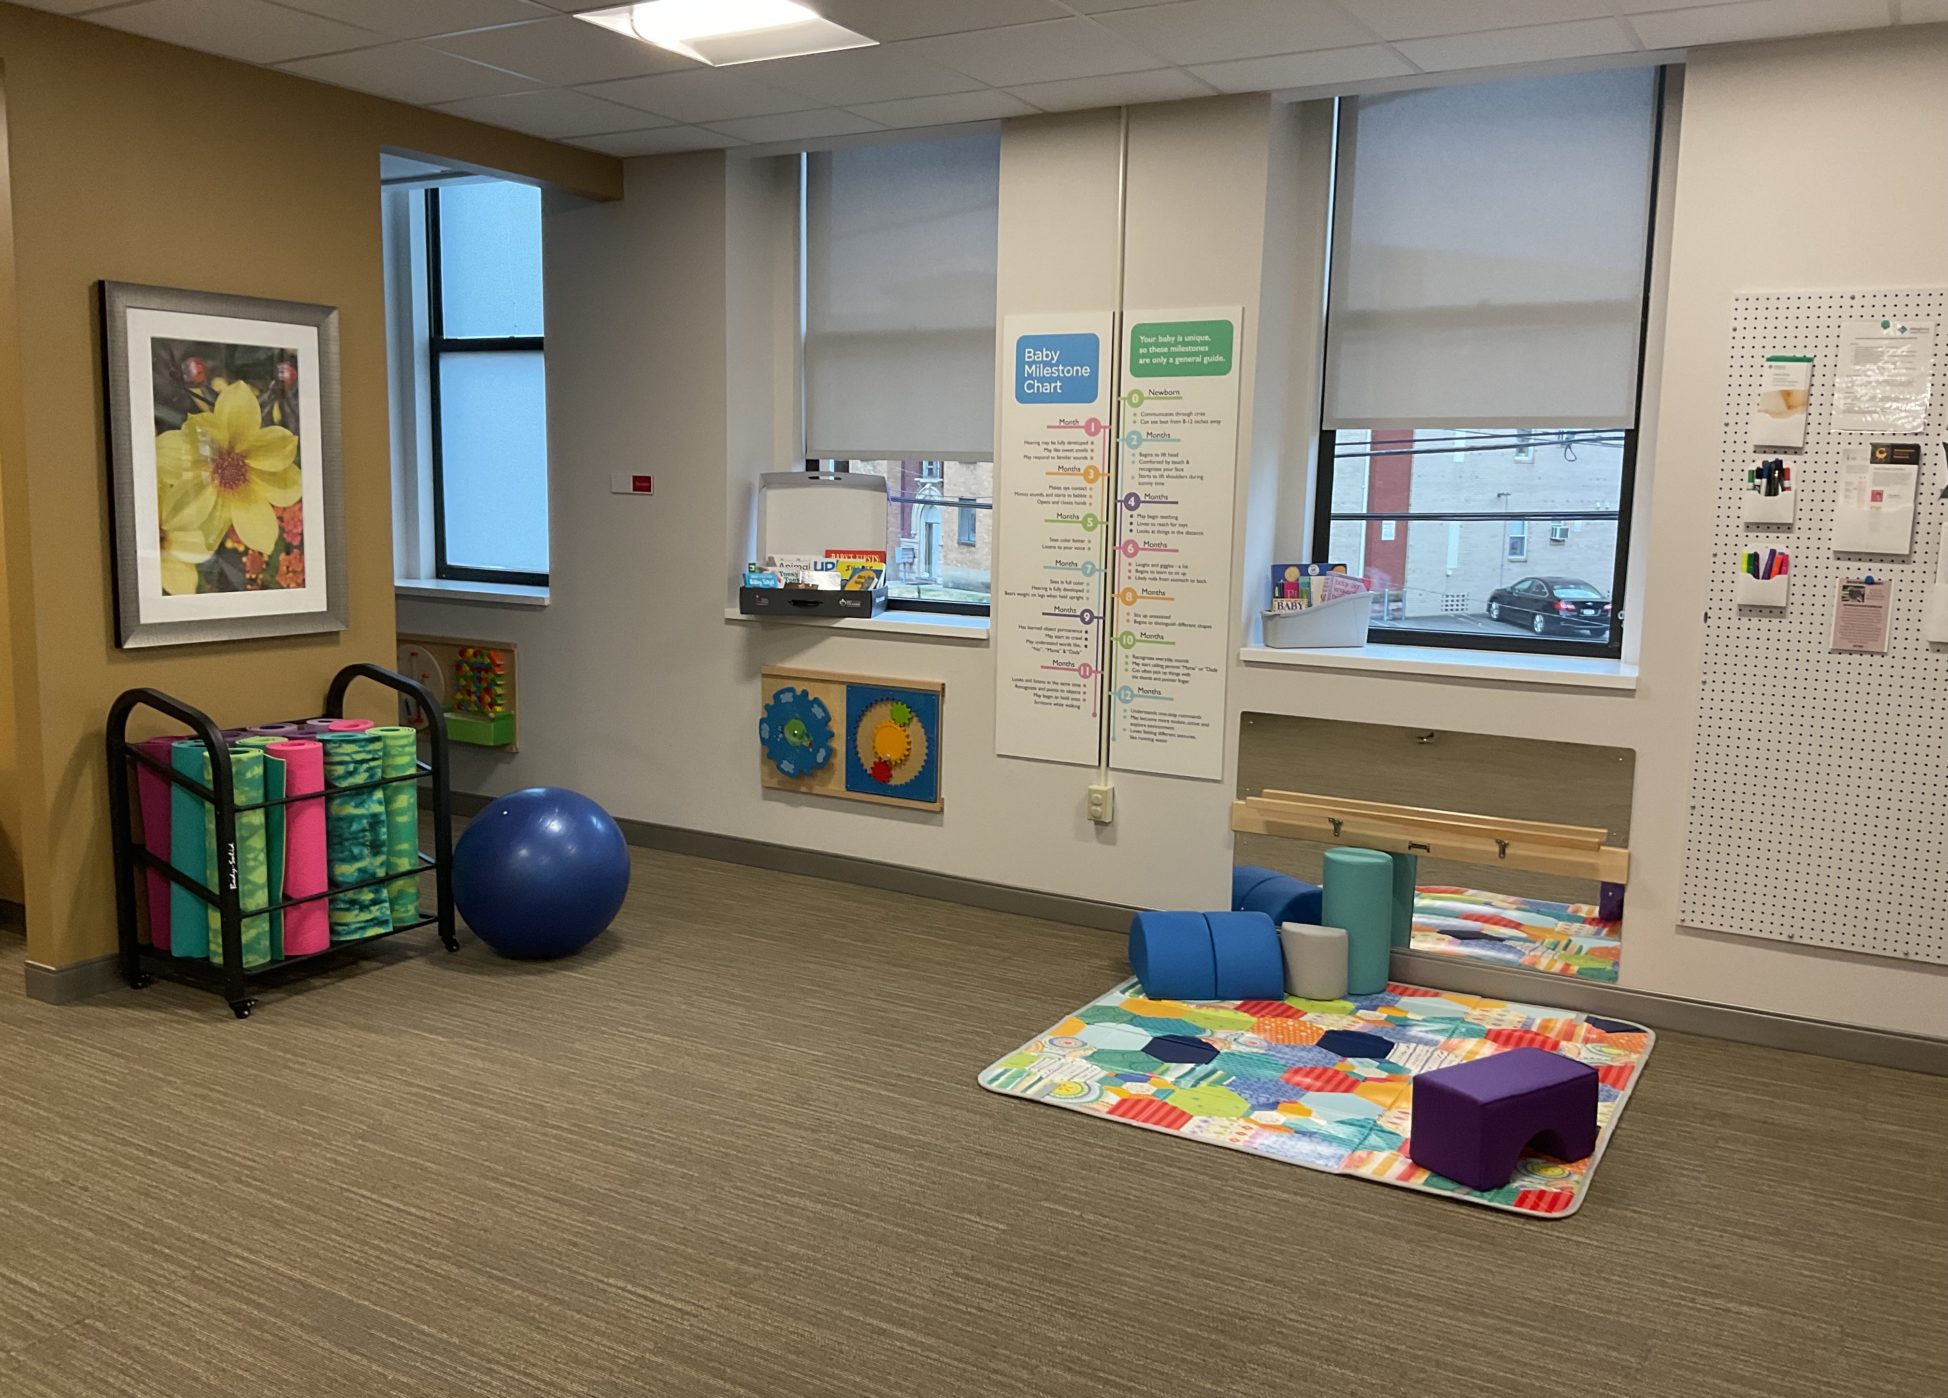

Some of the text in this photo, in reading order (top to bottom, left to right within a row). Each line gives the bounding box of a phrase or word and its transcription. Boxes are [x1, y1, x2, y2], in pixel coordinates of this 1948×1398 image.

[1158, 335, 1175, 344] baby
[1185, 335, 1211, 343] unique,
[1025, 348, 1060, 364] Baby
[1152, 356, 1168, 365] only
[1175, 355, 1202, 365] general
[1204, 354, 1225, 364] guide.
[1024, 364, 1090, 377] Milestone
[1024, 380, 1062, 393] Chart
[1091, 422, 1095, 432] 1
[1130, 436, 1138, 445] 2
[1088, 471, 1094, 480] 3
[1128, 497, 1136, 506] 4
[1087, 518, 1093, 527] 5
[1127, 544, 1135, 553] 6
[1086, 565, 1092, 574] 7
[1126, 591, 1132, 600] 8
[1277, 600, 1304, 610] BABY
[1054, 606, 1091, 622] Months 9
[1122, 632, 1164, 645] 10 Months
[1121, 687, 1162, 700] 12 Months
